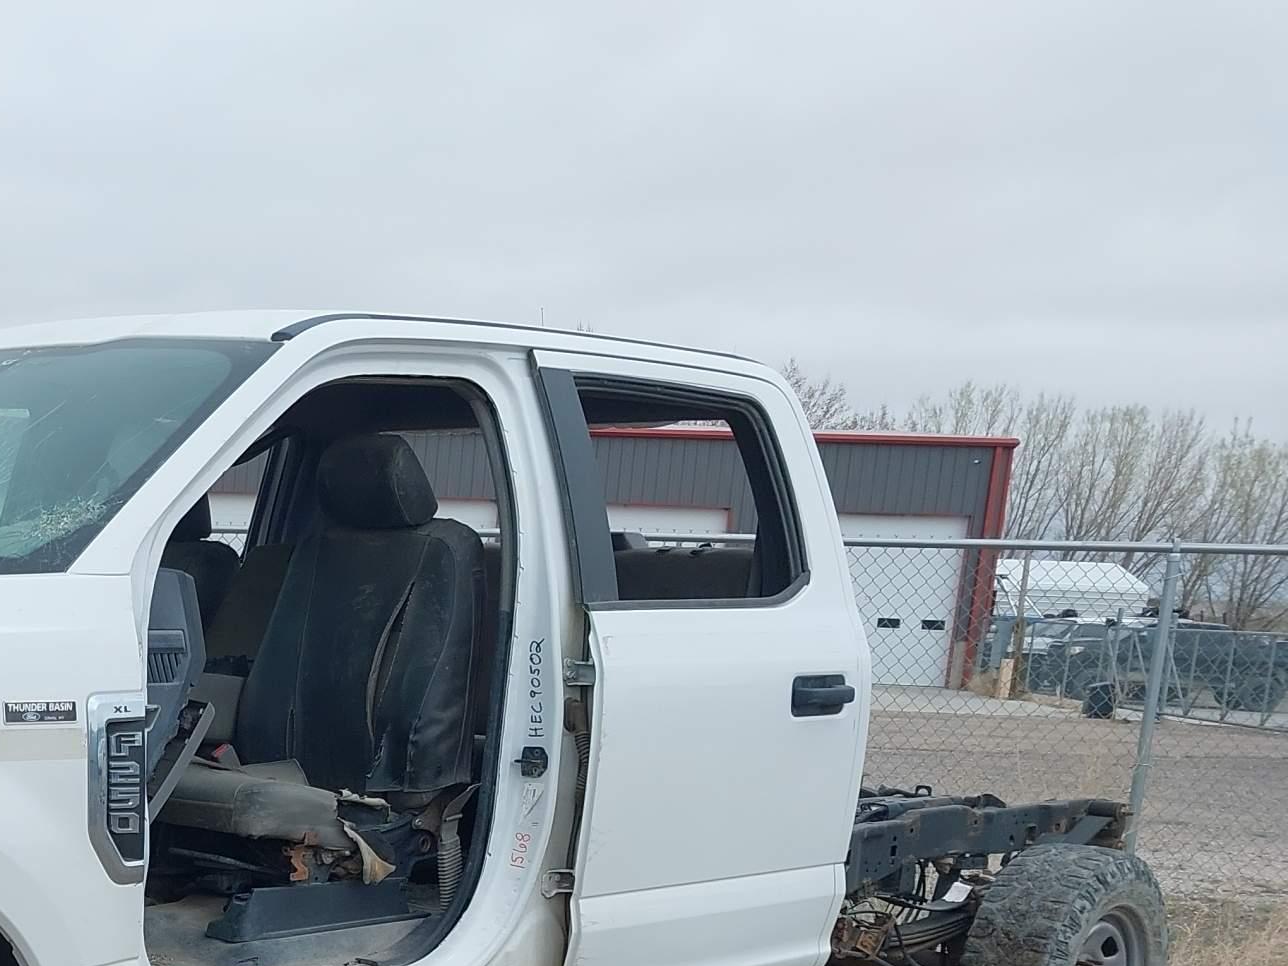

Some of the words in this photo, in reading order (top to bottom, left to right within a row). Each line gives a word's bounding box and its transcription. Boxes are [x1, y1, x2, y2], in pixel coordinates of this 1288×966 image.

[7, 703, 47, 712] THUNDER
[48, 702, 73, 711] BASIN
[113, 705, 131, 713] XL
[109, 732, 143, 833] F250
